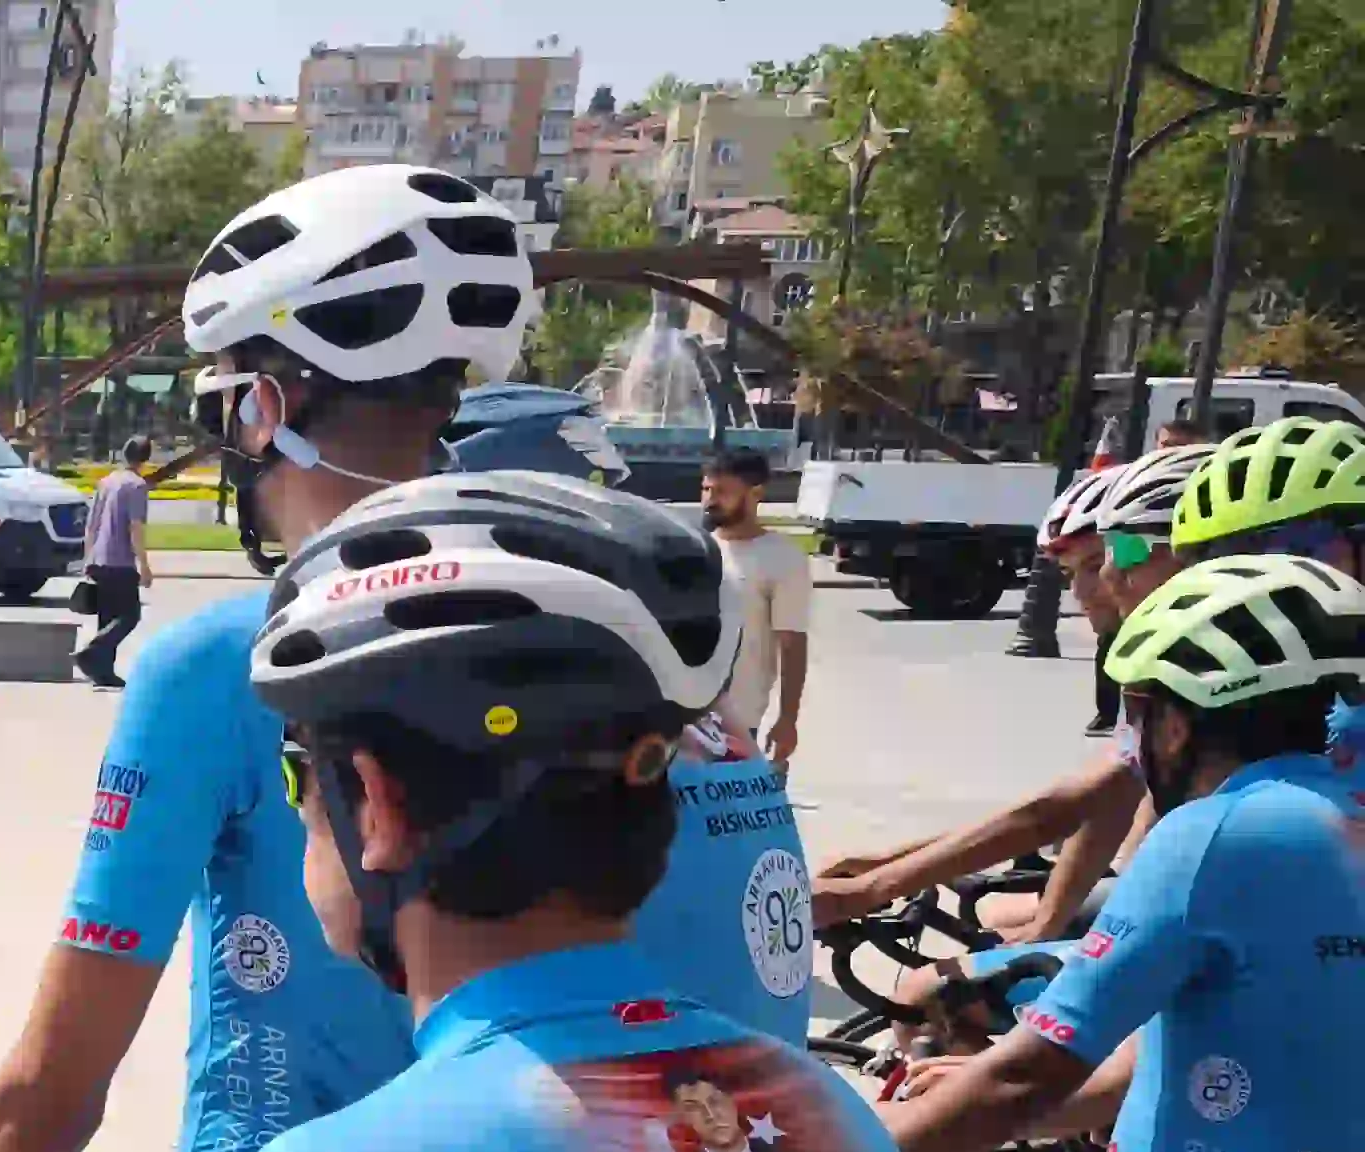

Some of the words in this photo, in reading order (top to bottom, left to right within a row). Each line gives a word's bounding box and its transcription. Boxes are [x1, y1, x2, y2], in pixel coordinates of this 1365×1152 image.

[365, 561, 462, 590] GIRO
[61, 917, 142, 951] ANO
[259, 1022, 291, 1149] ARNAVU
